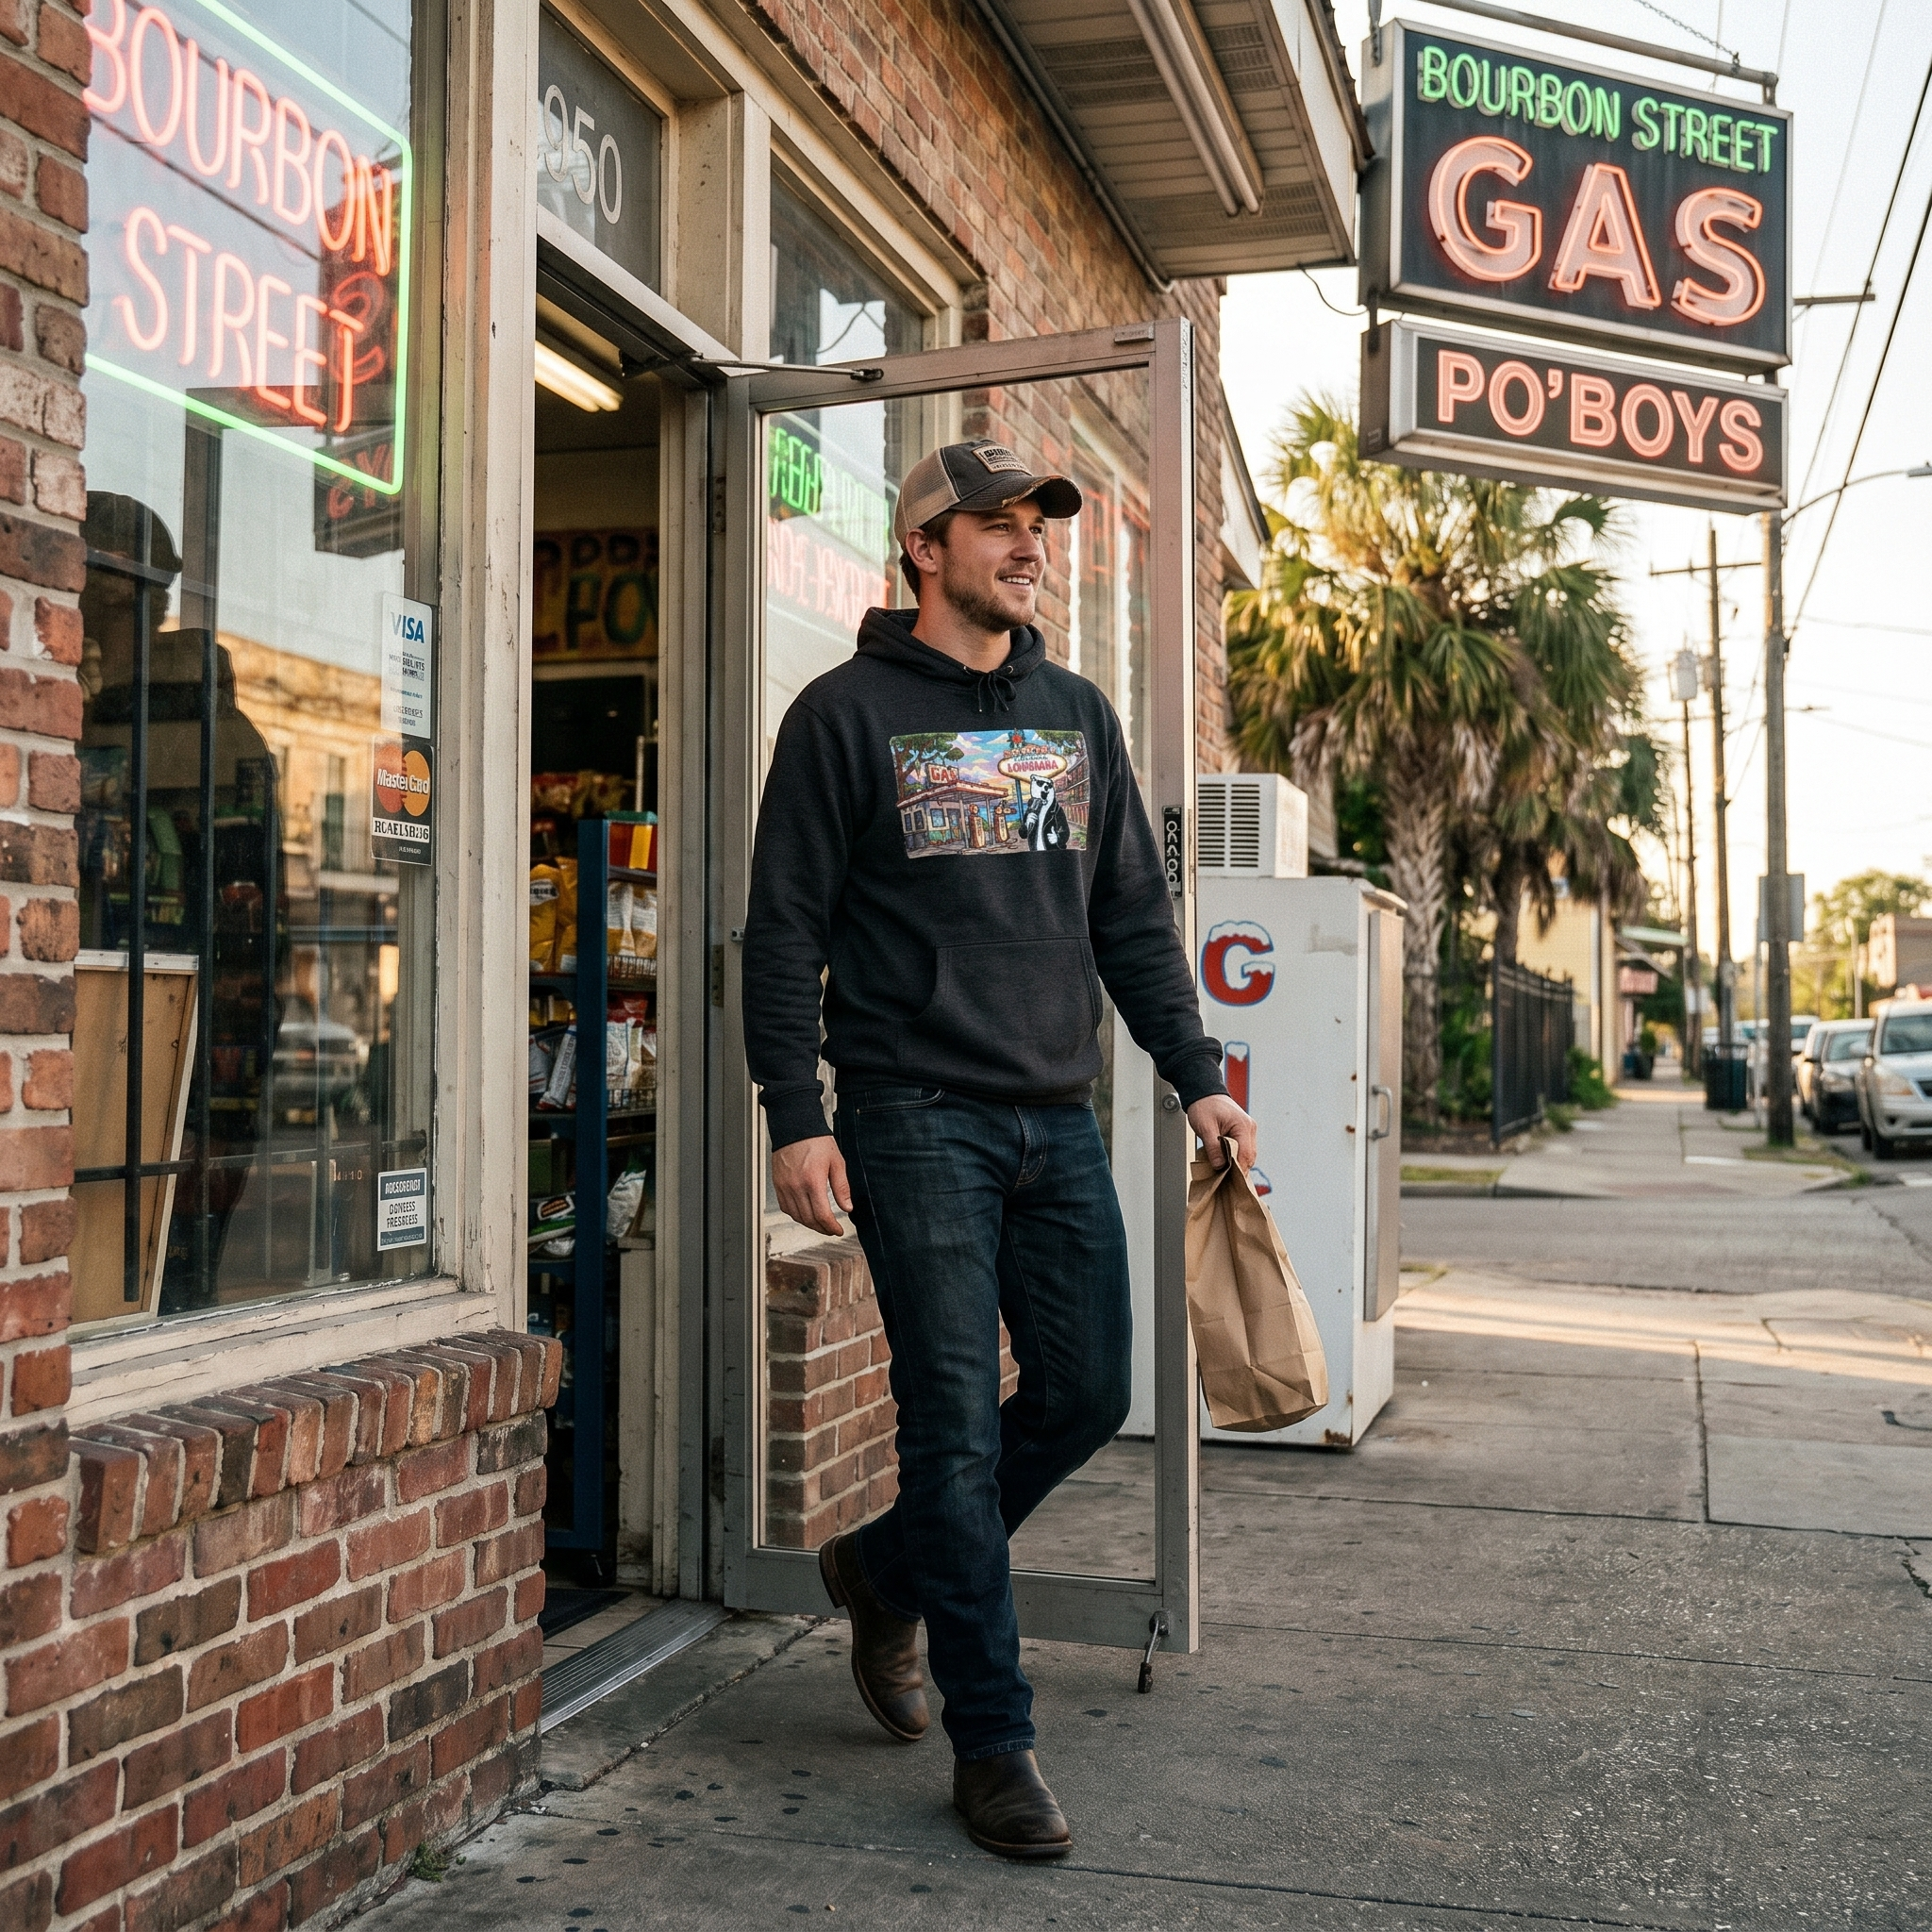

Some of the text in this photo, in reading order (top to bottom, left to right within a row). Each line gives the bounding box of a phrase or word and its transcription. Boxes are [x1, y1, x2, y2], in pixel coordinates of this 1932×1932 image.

[83, 0, 393, 276] BOURBON
[543, 84, 623, 225] 950
[1417, 45, 1778, 174] BOURBON STREET
[1427, 135, 1766, 326] GAS
[115, 207, 364, 433] STREET
[1437, 349, 1764, 472] PO'BOYS
[390, 611, 425, 643] VISA
